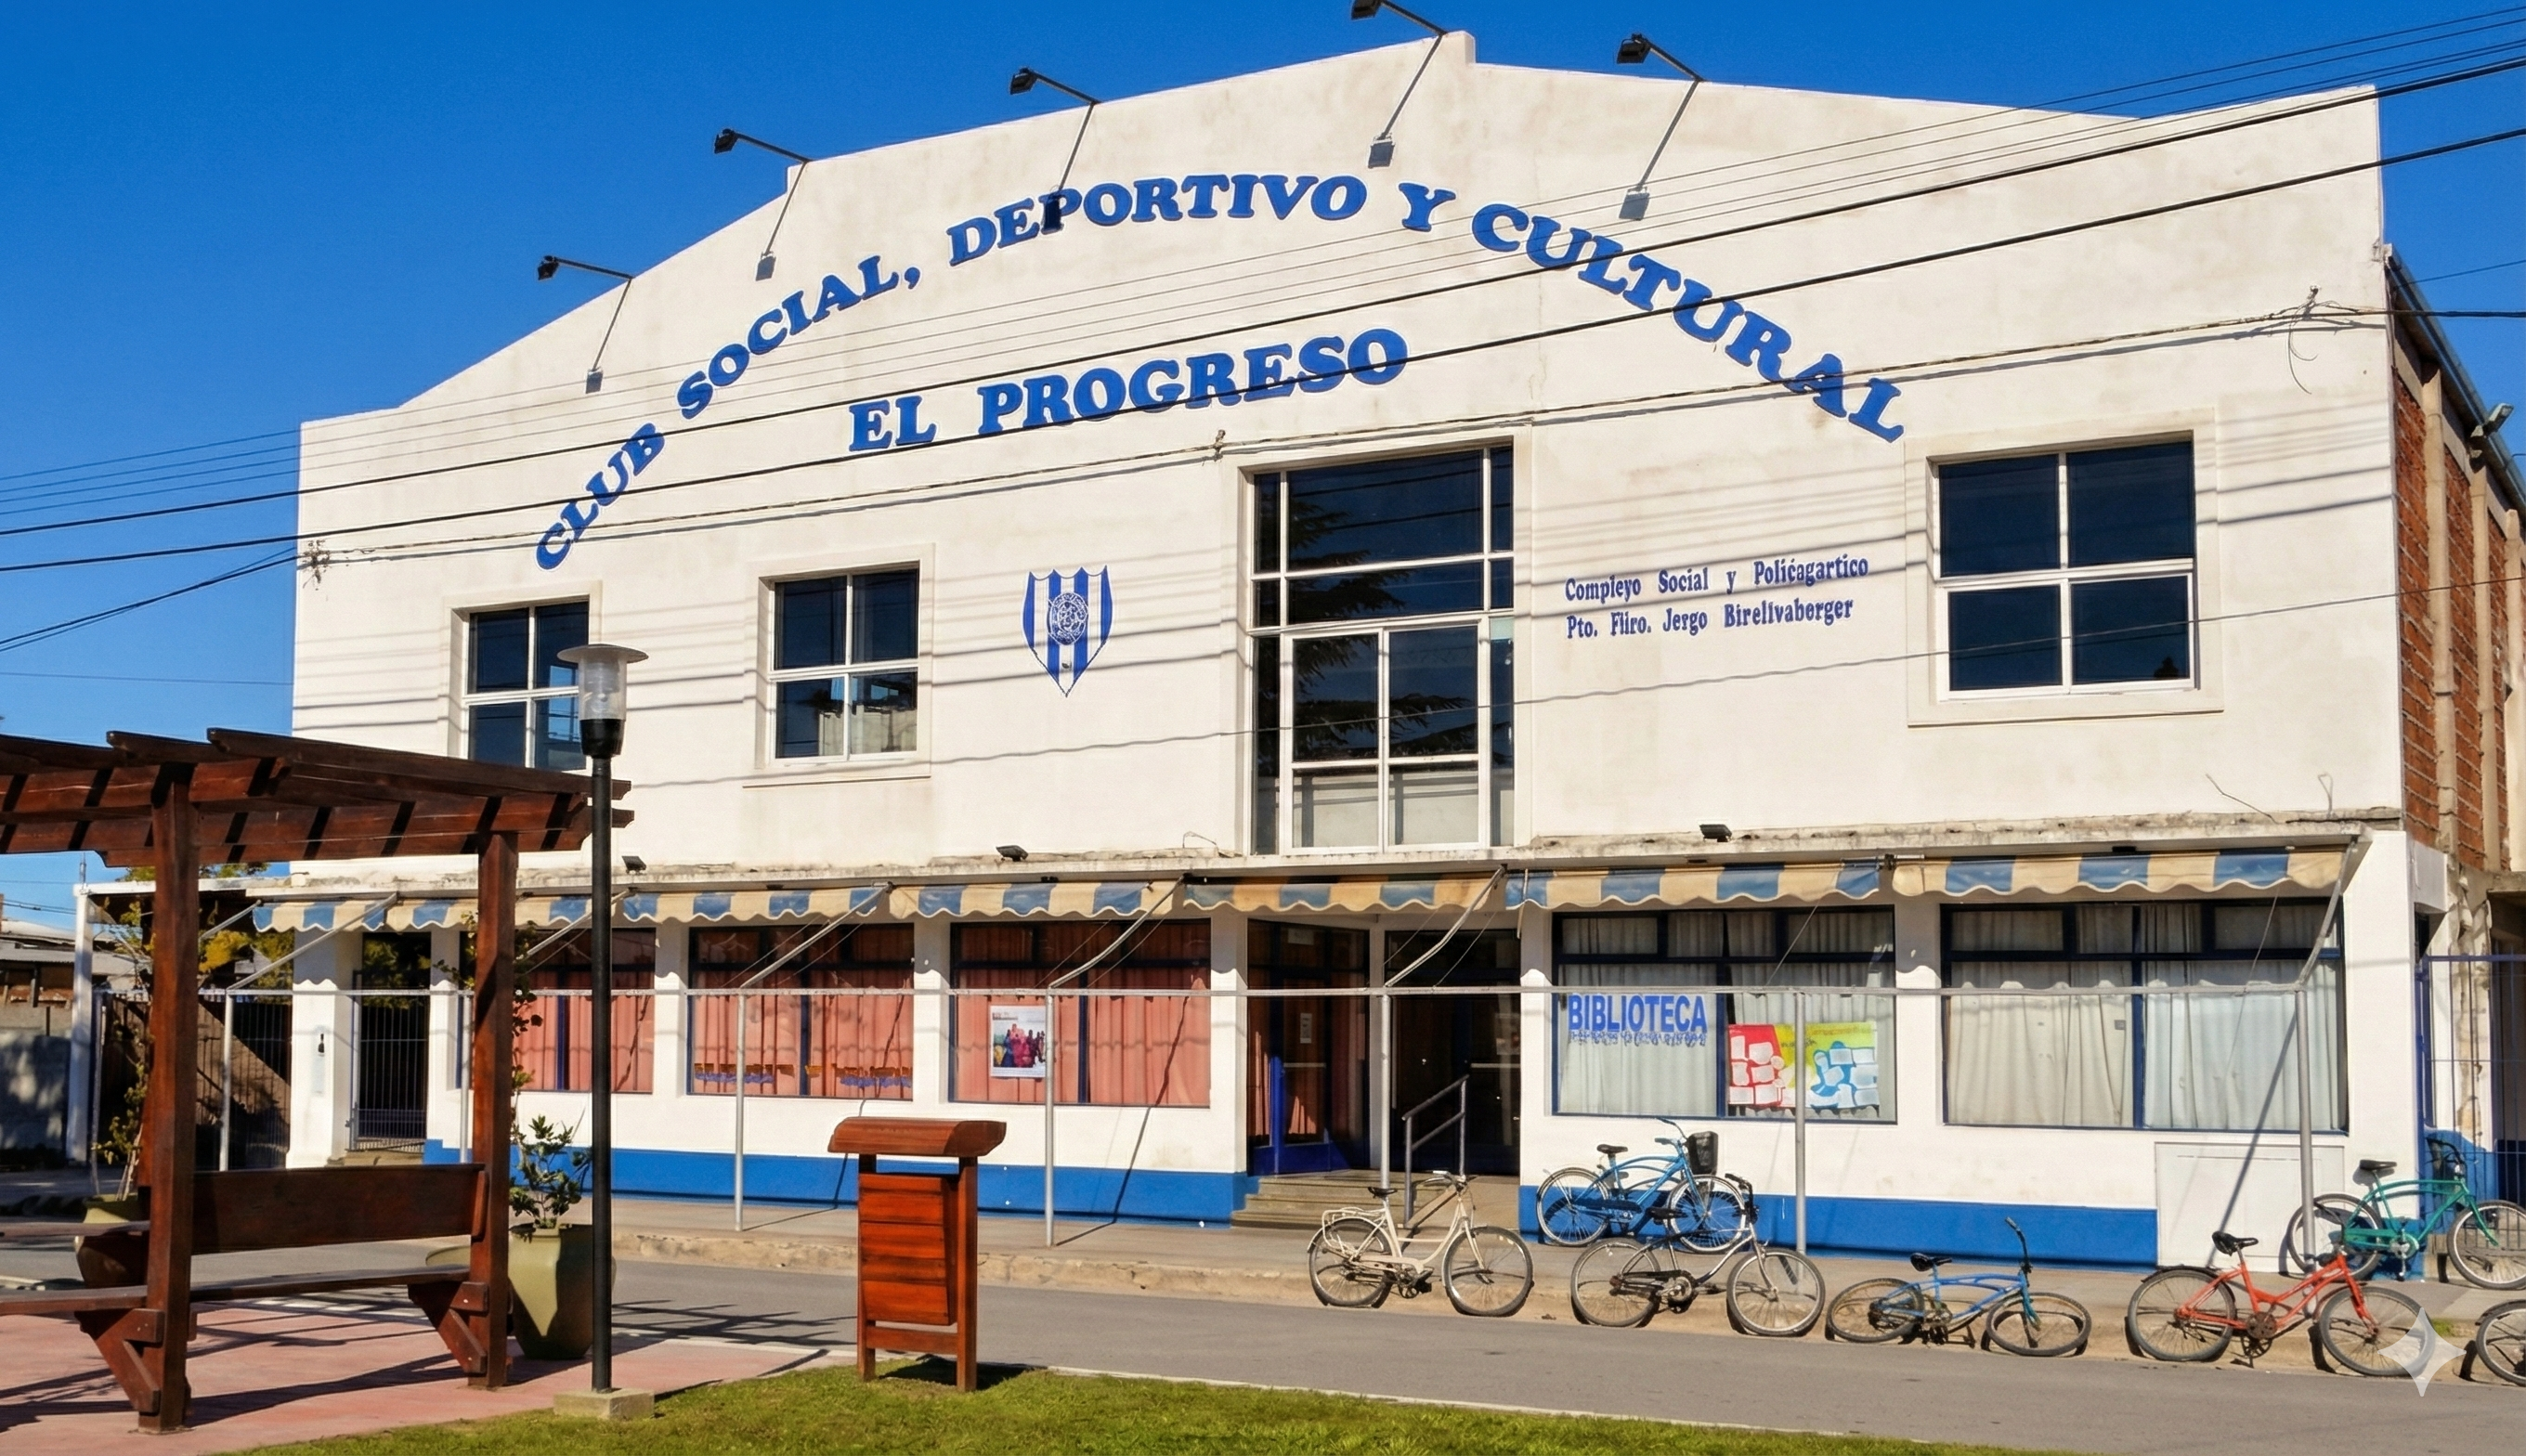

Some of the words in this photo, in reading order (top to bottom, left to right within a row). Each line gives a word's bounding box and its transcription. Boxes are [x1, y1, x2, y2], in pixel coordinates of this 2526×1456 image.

[536, 422, 665, 571] CLUB
[677, 254, 922, 420] SOCIAL,
[947, 175, 1368, 266] DEPORTIVO
[1399, 182, 1456, 231] Y
[1472, 203, 1905, 443] CULTURAL
[849, 396, 937, 452] EL
[977, 328, 1409, 436] PROGRESO
[1658, 567, 1709, 593] Social
[1725, 570, 1738, 594] y
[1567, 615, 1598, 639] Pto.
[1568, 994, 1708, 1034] BIBLIOTECA
